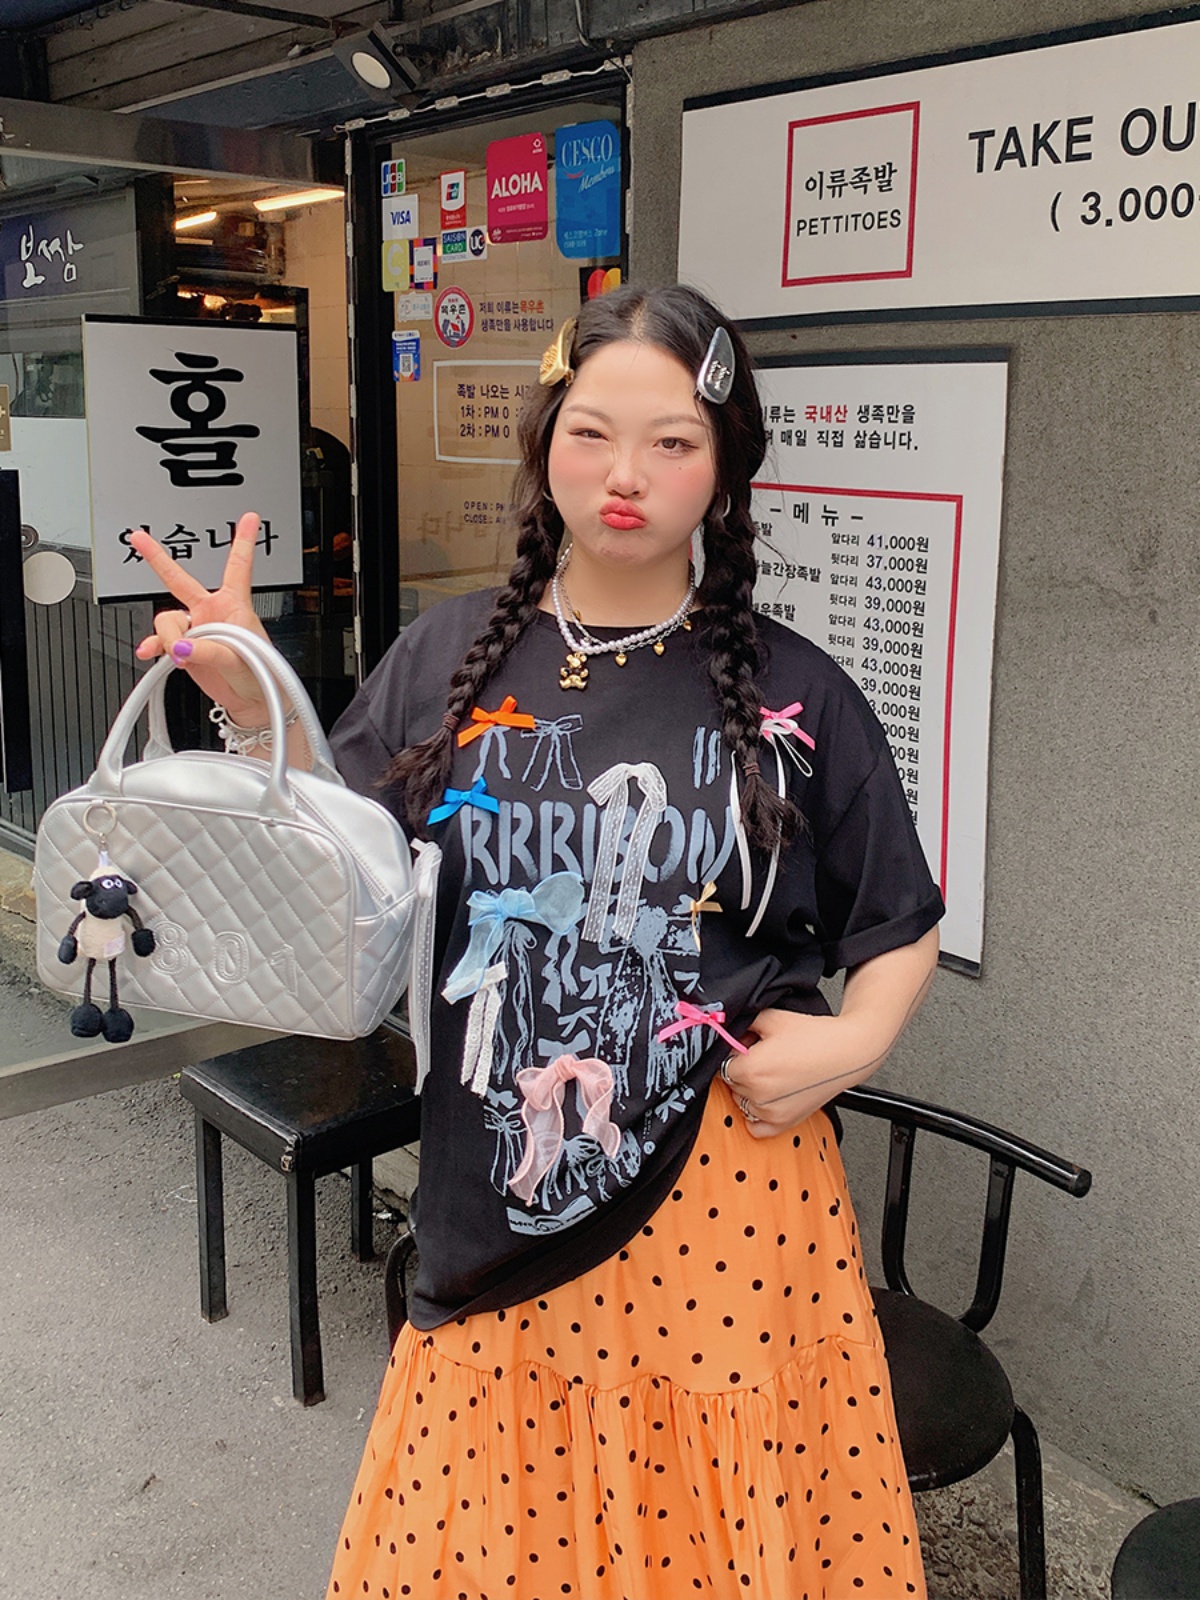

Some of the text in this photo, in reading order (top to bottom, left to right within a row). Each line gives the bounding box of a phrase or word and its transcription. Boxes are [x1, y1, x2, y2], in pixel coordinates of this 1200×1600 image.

[561, 133, 613, 168] CESCO
[968, 115, 1094, 174] TAKE
[382, 171, 404, 185] JCB
[491, 171, 543, 199] ALOHA
[805, 161, 898, 201] 이류족발
[1080, 182, 1200, 227] 3.000
[390, 210, 412, 226] VISA
[796, 208, 902, 237] PETTITOES
[470, 234, 485, 250] UC
[513, 317, 554, 332] 사용합니다
[457, 383, 476, 399] 족발
[480, 384, 510, 399] 나오는
[135, 350, 260, 488] 홀
[484, 406, 499, 419] PM
[764, 404, 916, 424] 류는 국내산 생족만을
[485, 424, 500, 438] PM
[780, 429, 807, 447] 매일
[816, 430, 844, 448] 직접
[464, 500, 488, 511] OPEN
[464, 513, 487, 524] CLOSE
[831, 533, 860, 546] 앞다리
[831, 553, 928, 573] 뒷다리 37,000원
[757, 560, 927, 595] 늘간장족발 앞다리 43,000원
[829, 593, 925, 616] 뒷다리 39,000원
[828, 614, 856, 628] 앞다리
[863, 616, 924, 638] 43,000원
[828, 633, 923, 660] 뒷다리 39,000원
[861, 658, 922, 680] 43,000원
[868, 699, 920, 722] 3,000원
